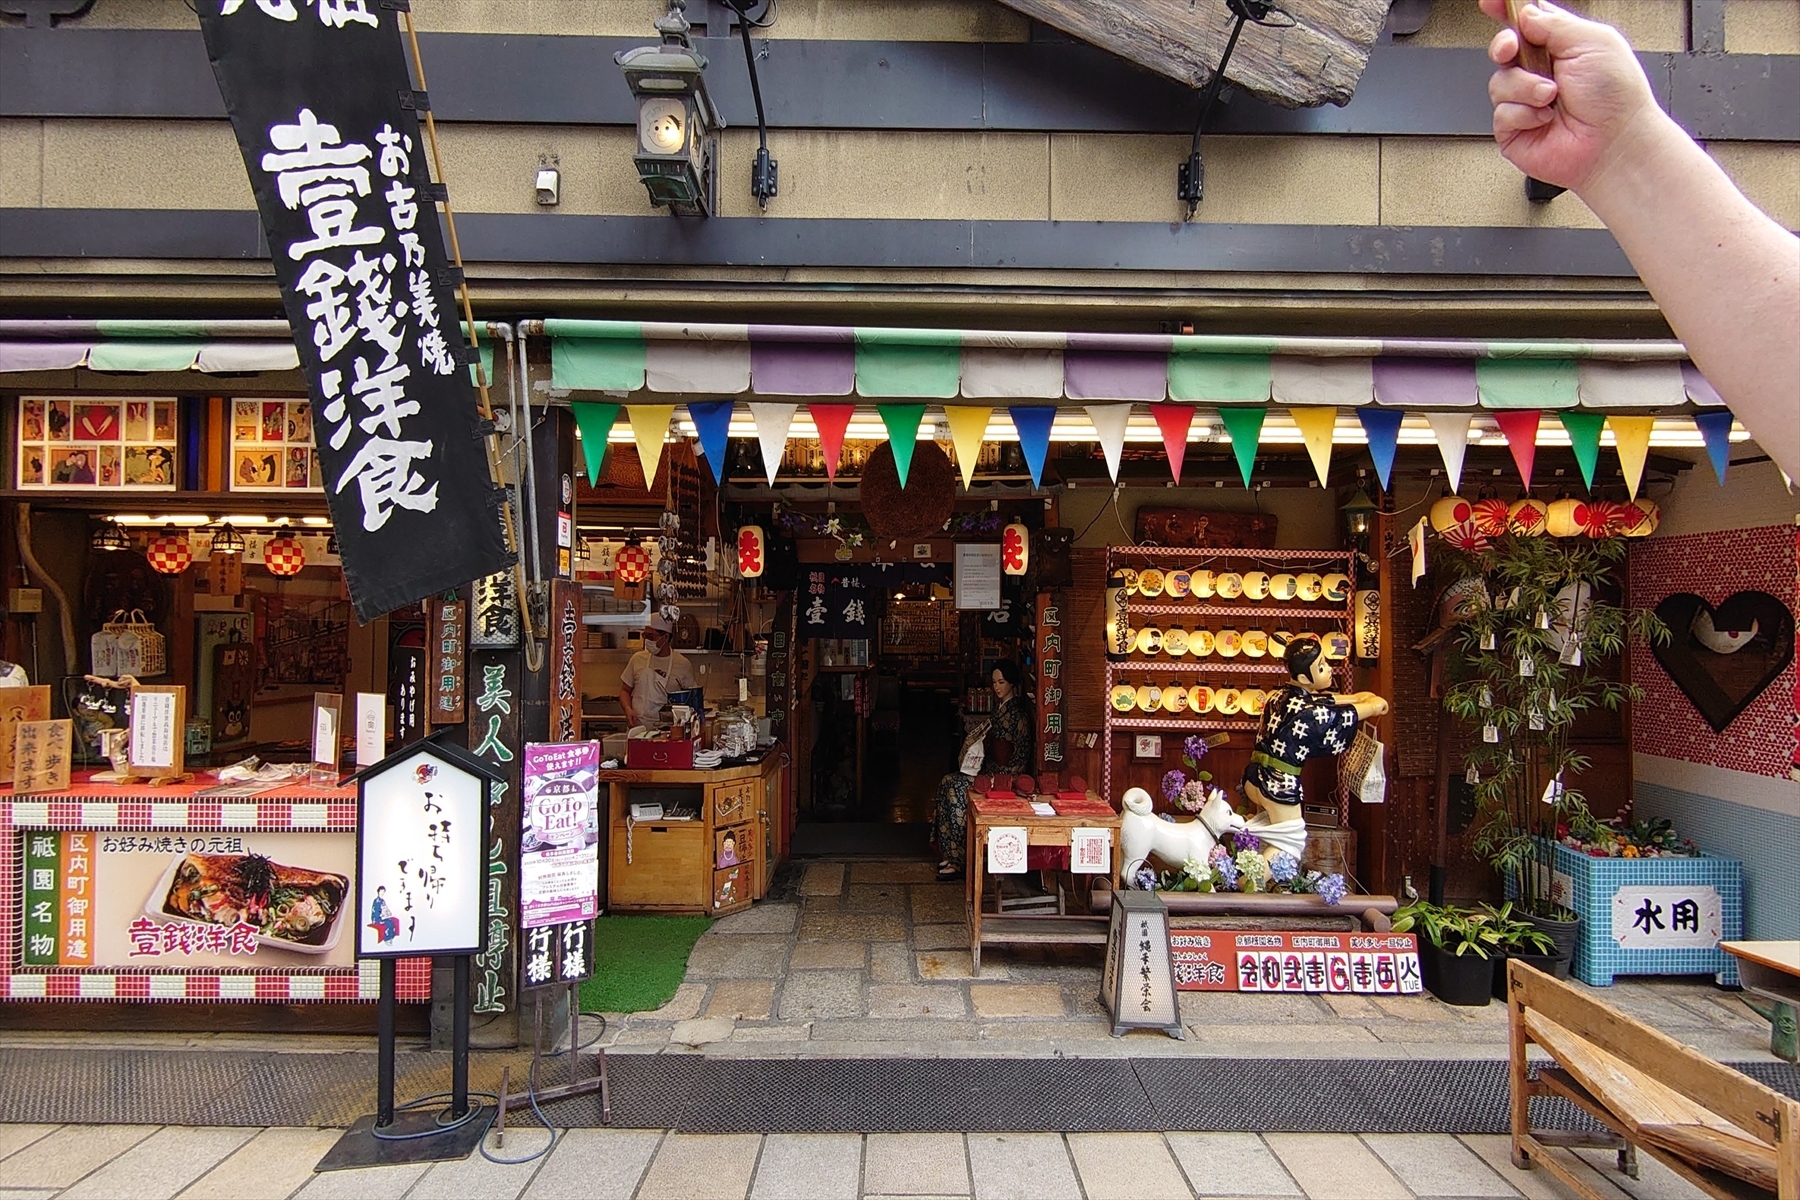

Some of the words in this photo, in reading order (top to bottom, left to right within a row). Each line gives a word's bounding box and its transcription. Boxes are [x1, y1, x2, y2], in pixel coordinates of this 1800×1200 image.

[544, 812, 578, 830] Eat!
[102, 836, 244, 854] お好み焼きの元祖
[66, 834, 90, 959] 区内町御用達
[1403, 980, 1420, 990] TUE
